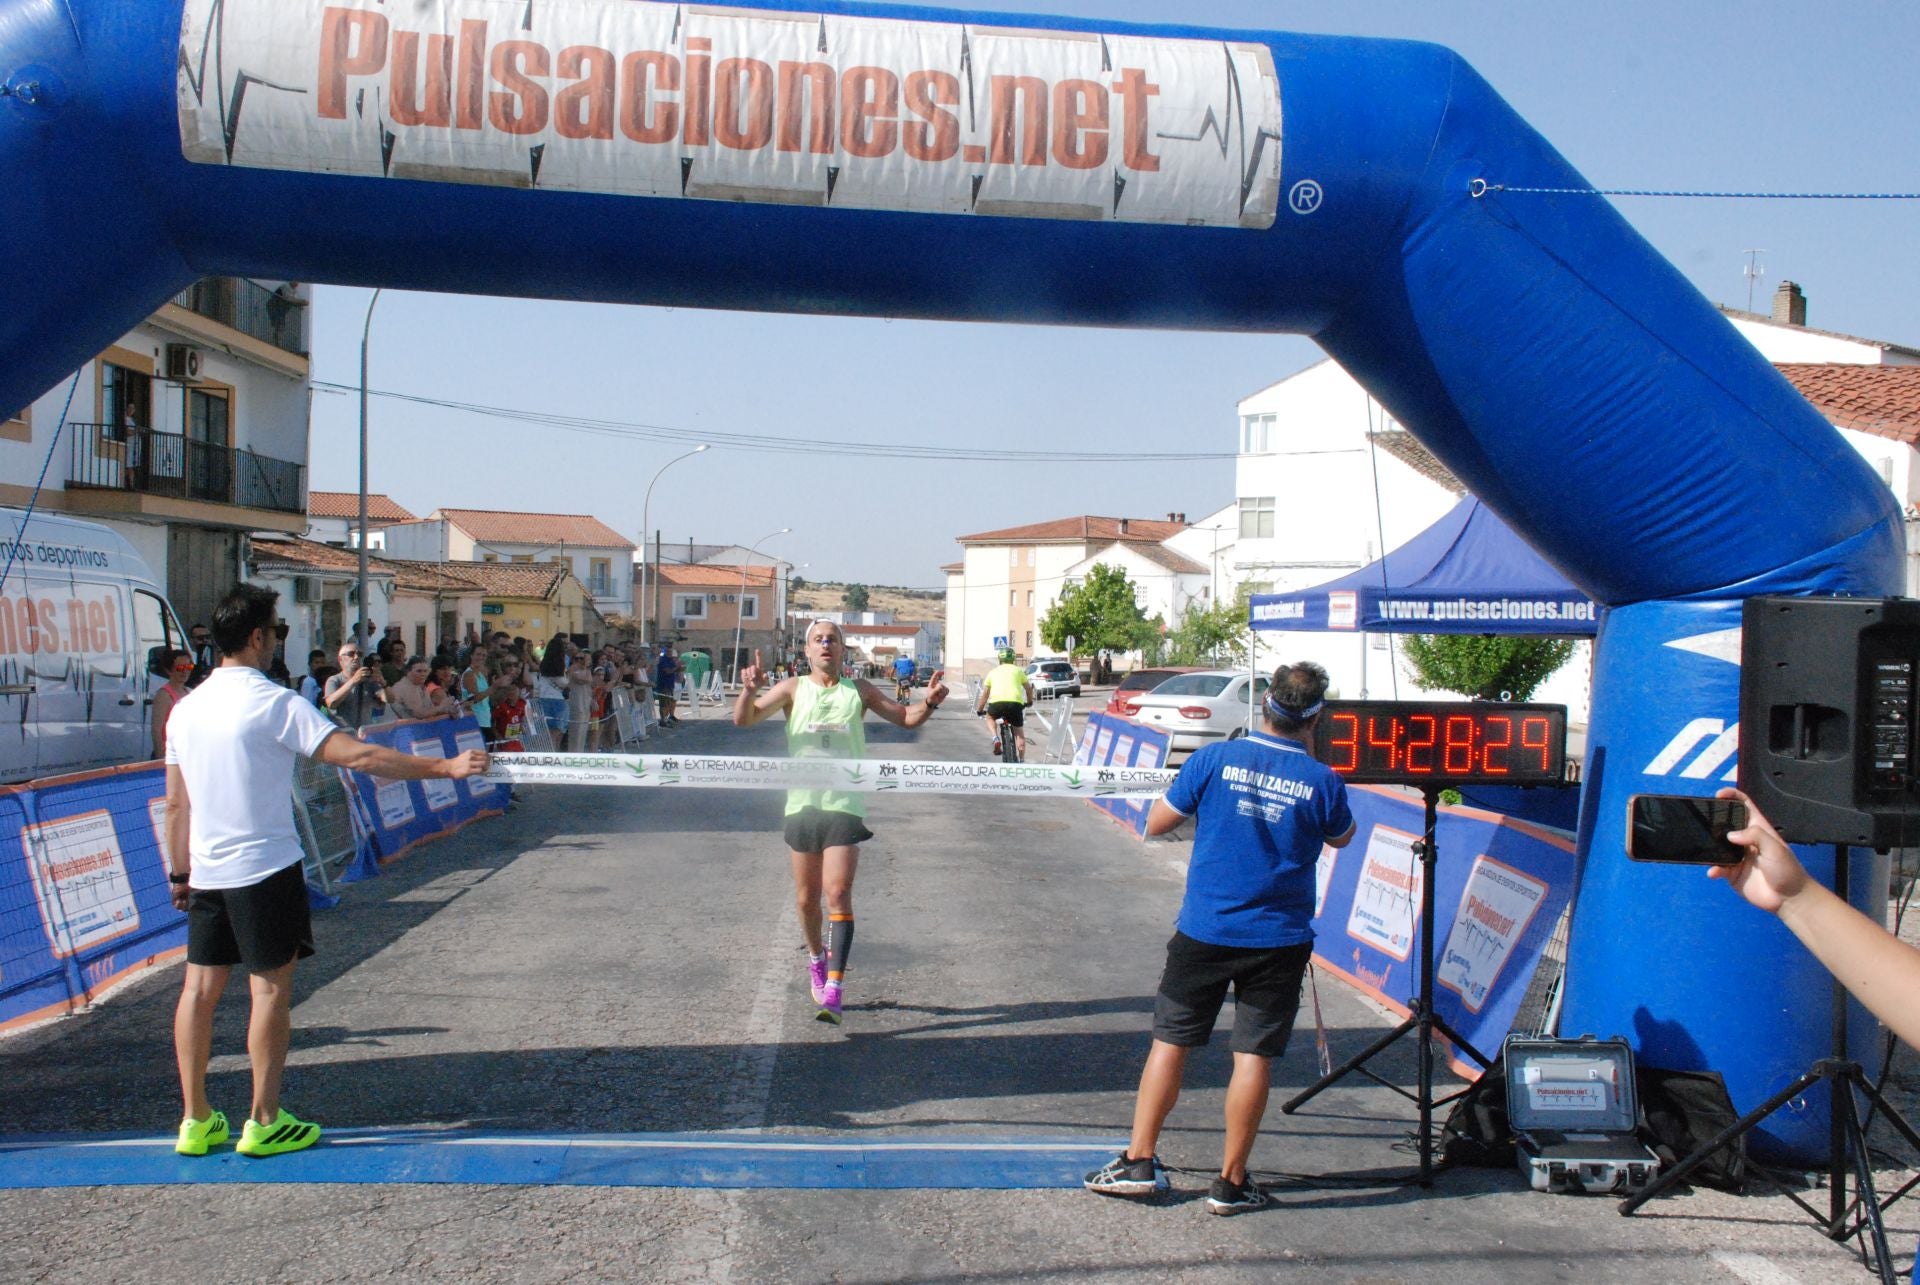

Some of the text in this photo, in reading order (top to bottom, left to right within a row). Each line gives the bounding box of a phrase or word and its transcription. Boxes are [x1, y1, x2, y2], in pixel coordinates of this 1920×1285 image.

[317, 6, 1160, 172] Pulsaciones.net
[38, 541, 109, 568] deportivos
[1378, 598, 1596, 621] www.pulsaciones.net
[1330, 712, 1549, 773] 34:28:29
[489, 755, 620, 768] REMADURA DEPORTE
[684, 759, 838, 774] EXTREMADURA DEPORTE
[902, 764, 1057, 779] EXTREMADURA DEPORTE
[905, 780, 939, 788] Dirección
[1019, 783, 1053, 792] Deportes
[1120, 770, 1174, 784] EXTREM
[1221, 764, 1315, 801] ORGANIZACIÓN
[1229, 783, 1297, 806] EVENTOS DEPORTIVOS
